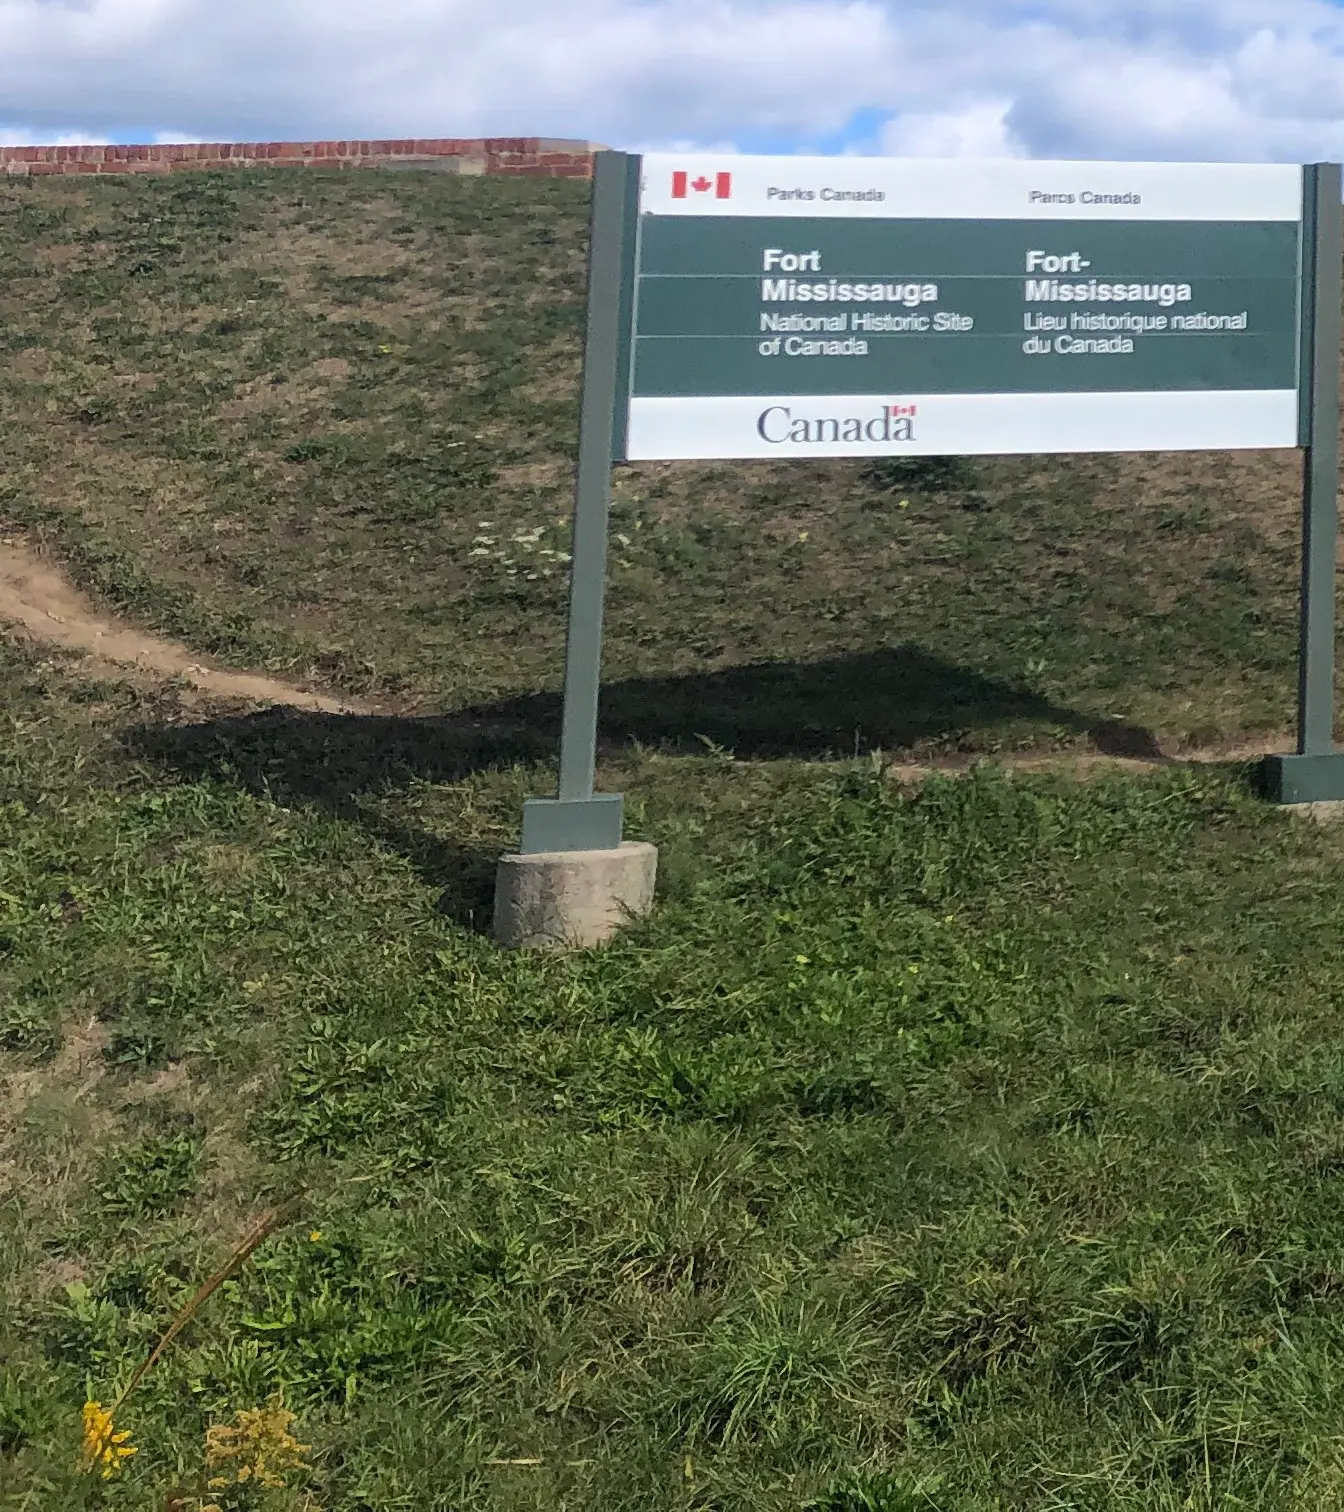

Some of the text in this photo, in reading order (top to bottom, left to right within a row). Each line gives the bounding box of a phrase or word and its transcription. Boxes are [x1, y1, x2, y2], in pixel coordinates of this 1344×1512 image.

[767, 186, 885, 202] Parks Canada
[1030, 190, 1142, 205] Parcs Canada
[763, 249, 821, 271] Fort
[1025, 250, 1091, 273] Fort-
[761, 279, 938, 307] Mississauga
[1024, 279, 1192, 306] Mississauga
[759, 311, 974, 332] National Historic Site
[1023, 311, 1248, 334] Lieu historique national
[758, 336, 869, 356] of Canada
[1022, 335, 1134, 354] du Canada
[756, 405, 917, 444] Canada
